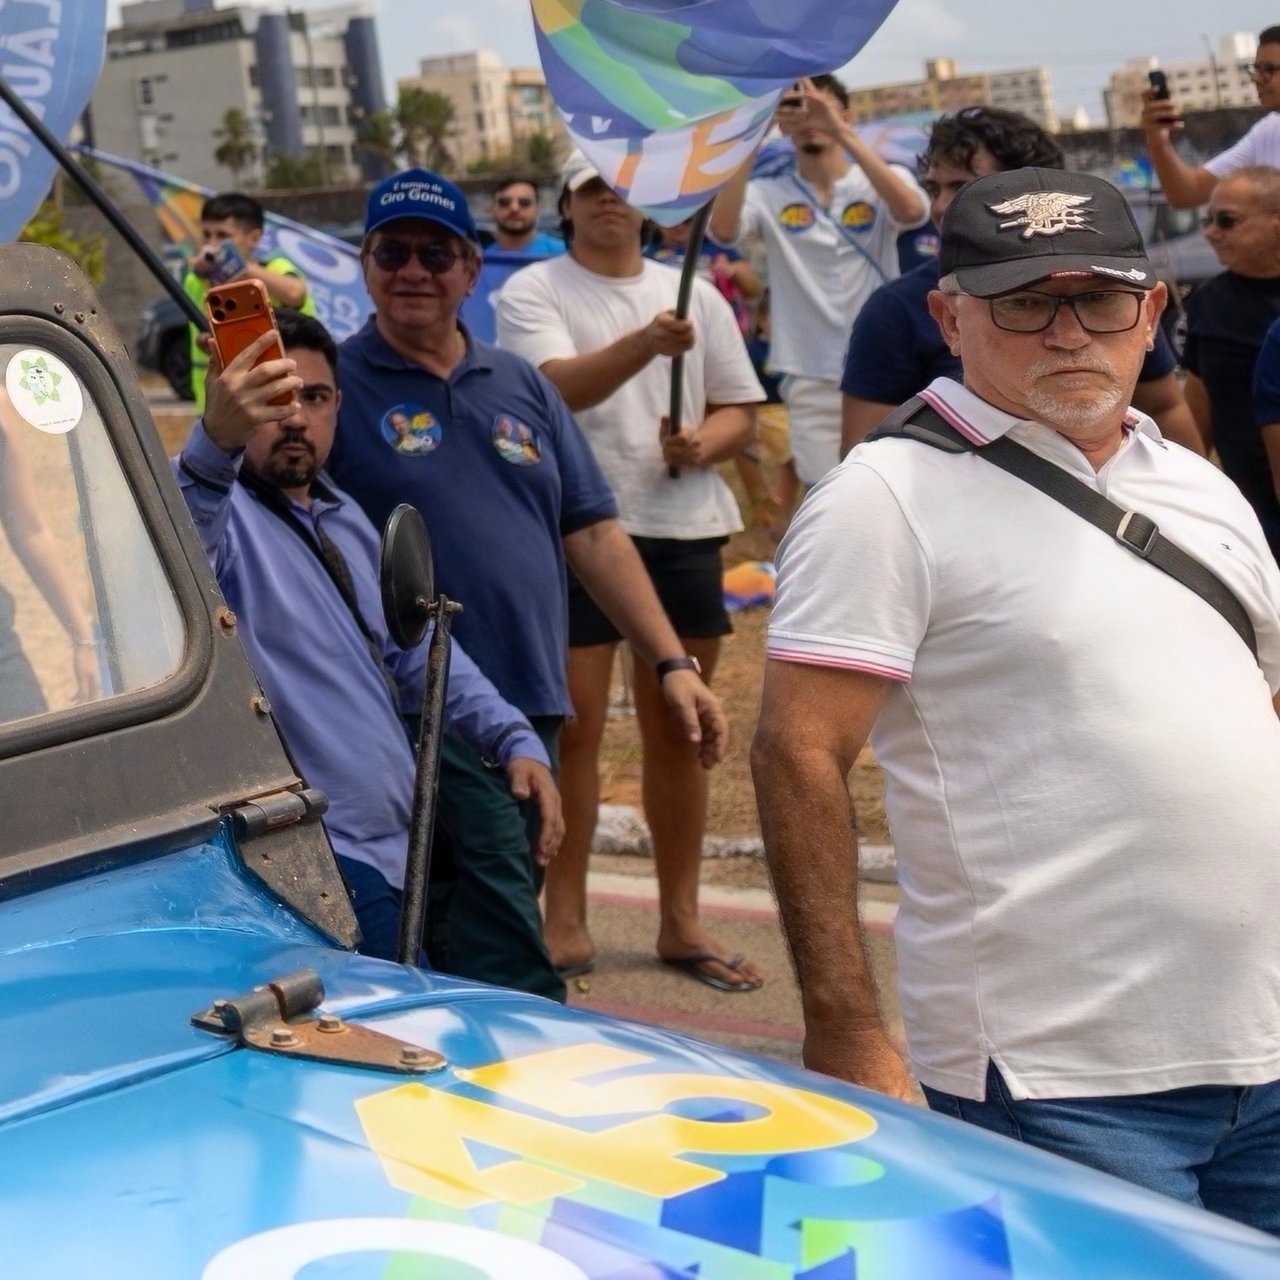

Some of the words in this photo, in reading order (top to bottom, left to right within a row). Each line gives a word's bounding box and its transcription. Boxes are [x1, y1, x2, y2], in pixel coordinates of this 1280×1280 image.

[380, 191, 405, 206] Ciro
[408, 189, 456, 212] Gomes
[353, 1042, 881, 1210] 45
